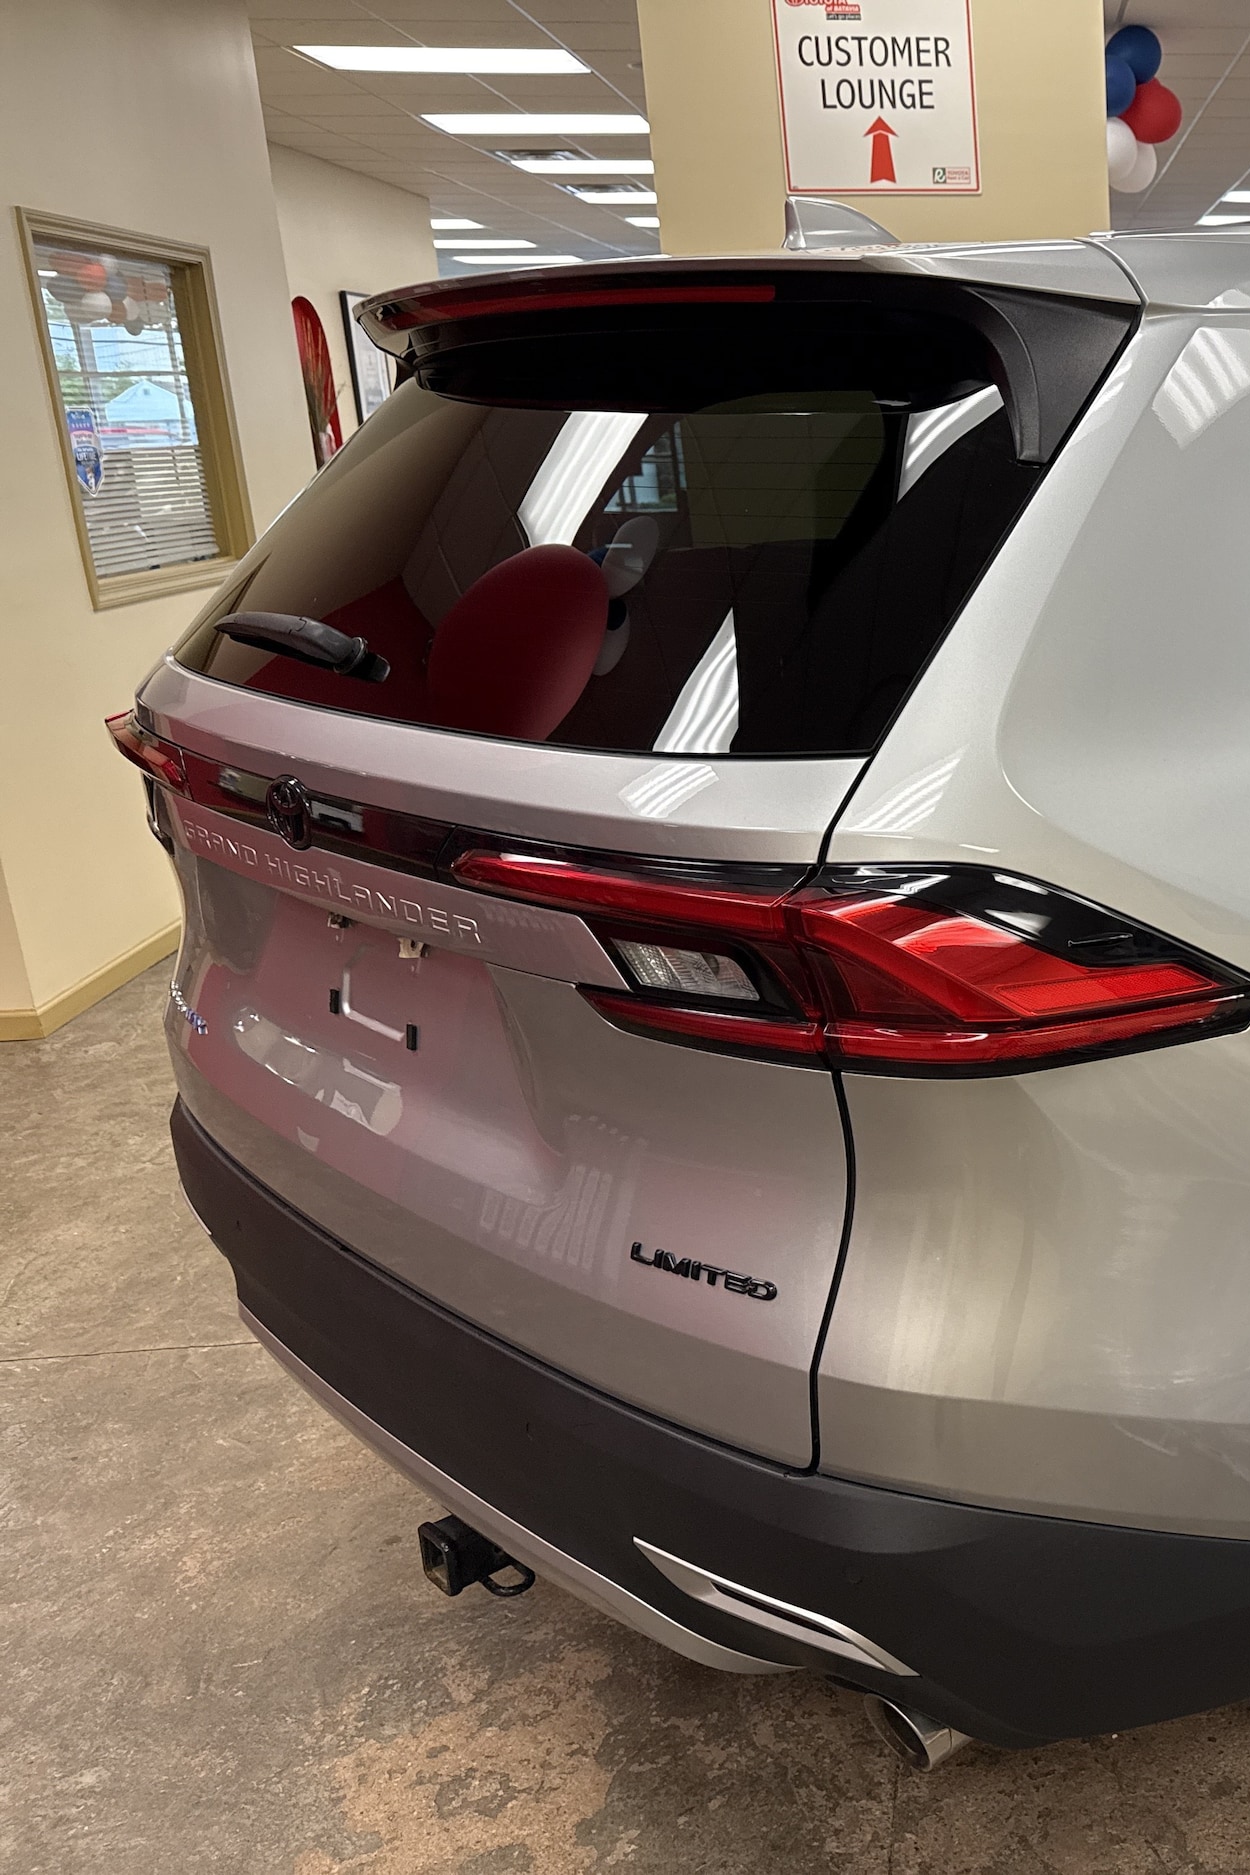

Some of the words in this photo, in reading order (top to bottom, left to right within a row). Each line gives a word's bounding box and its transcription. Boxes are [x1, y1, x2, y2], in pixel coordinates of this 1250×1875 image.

[798, 35, 952, 67] CUSTOMER
[820, 78, 935, 110] LOUNGE
[183, 819, 258, 867] GRAND
[264, 853, 482, 944] HIGHLANDER
[630, 1241, 778, 1301] LIMITED
